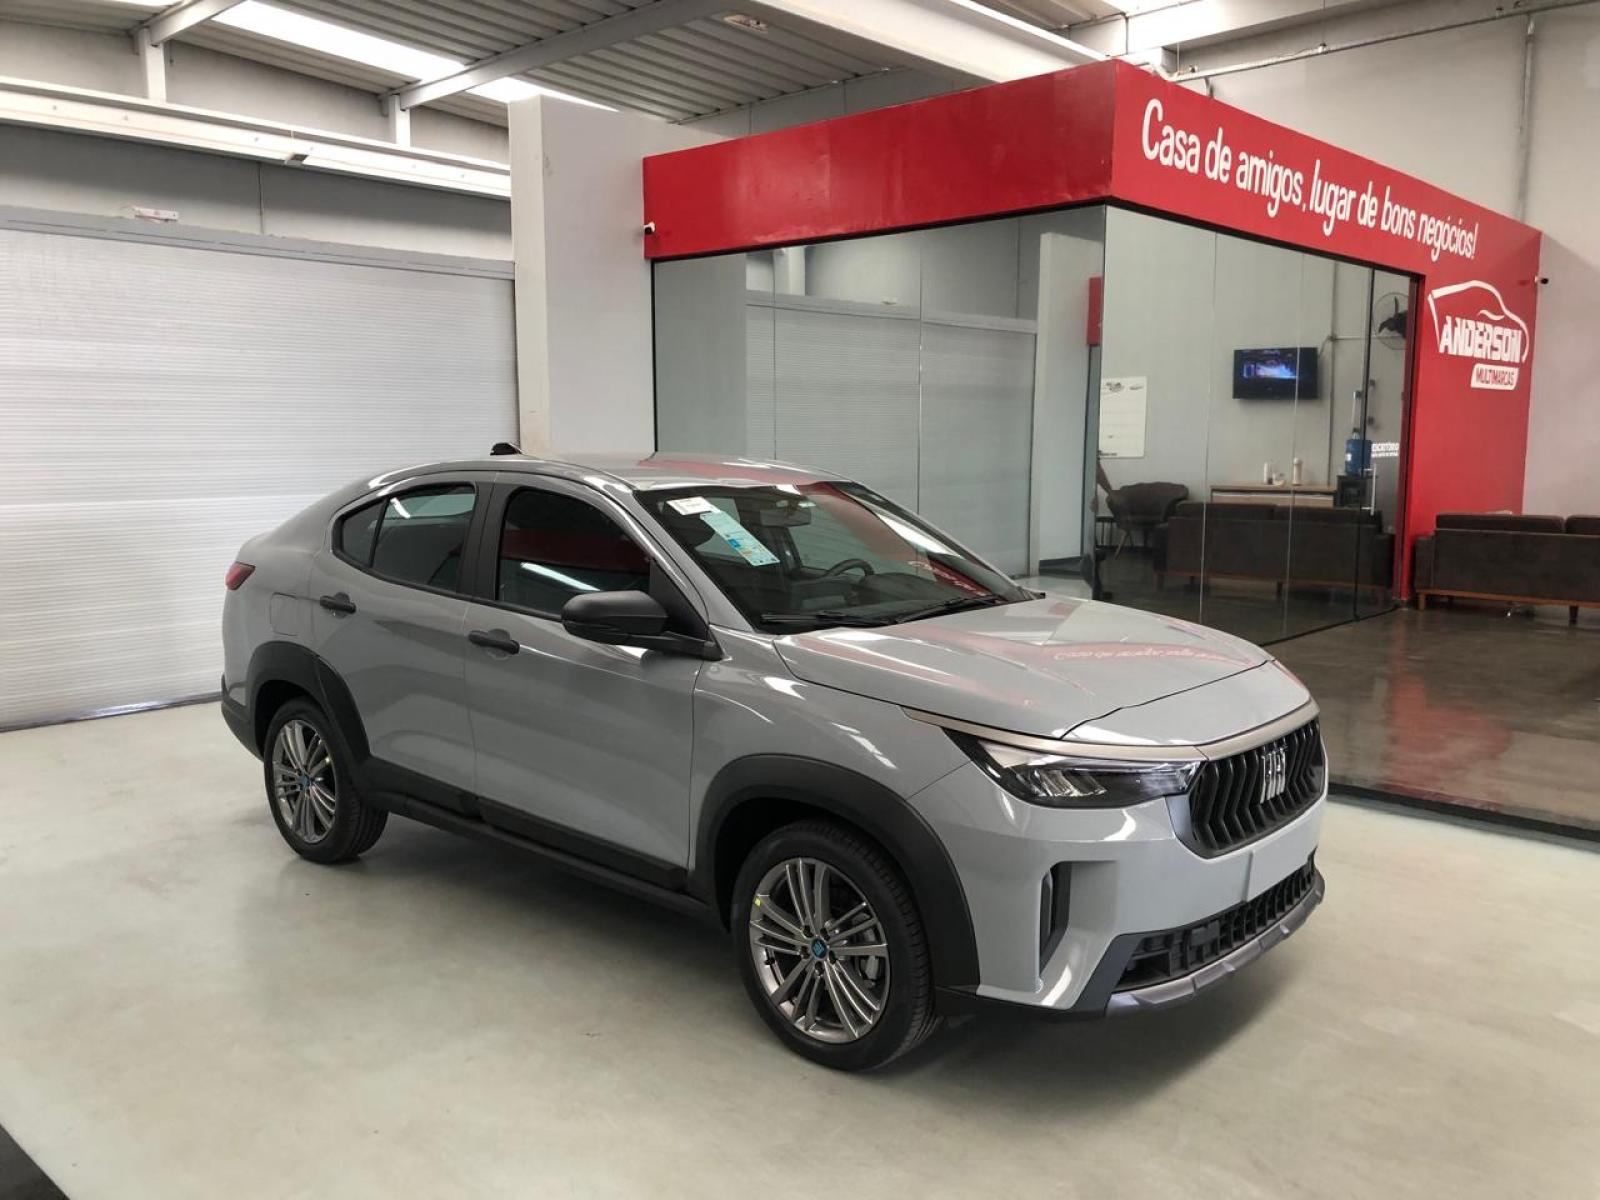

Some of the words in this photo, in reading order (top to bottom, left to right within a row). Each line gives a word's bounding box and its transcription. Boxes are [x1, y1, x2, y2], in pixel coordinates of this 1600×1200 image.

[1142, 99, 1201, 174] Casa
[1205, 127, 1233, 183] de
[1236, 150, 1306, 218] amigos,
[1309, 160, 1357, 236] lugar
[1358, 181, 1379, 228] de
[1381, 186, 1417, 239] bons
[1417, 213, 1479, 262] negócios!
[1439, 315, 1522, 363] ANDERSON
[1475, 367, 1515, 386] MULTIMARCAS
